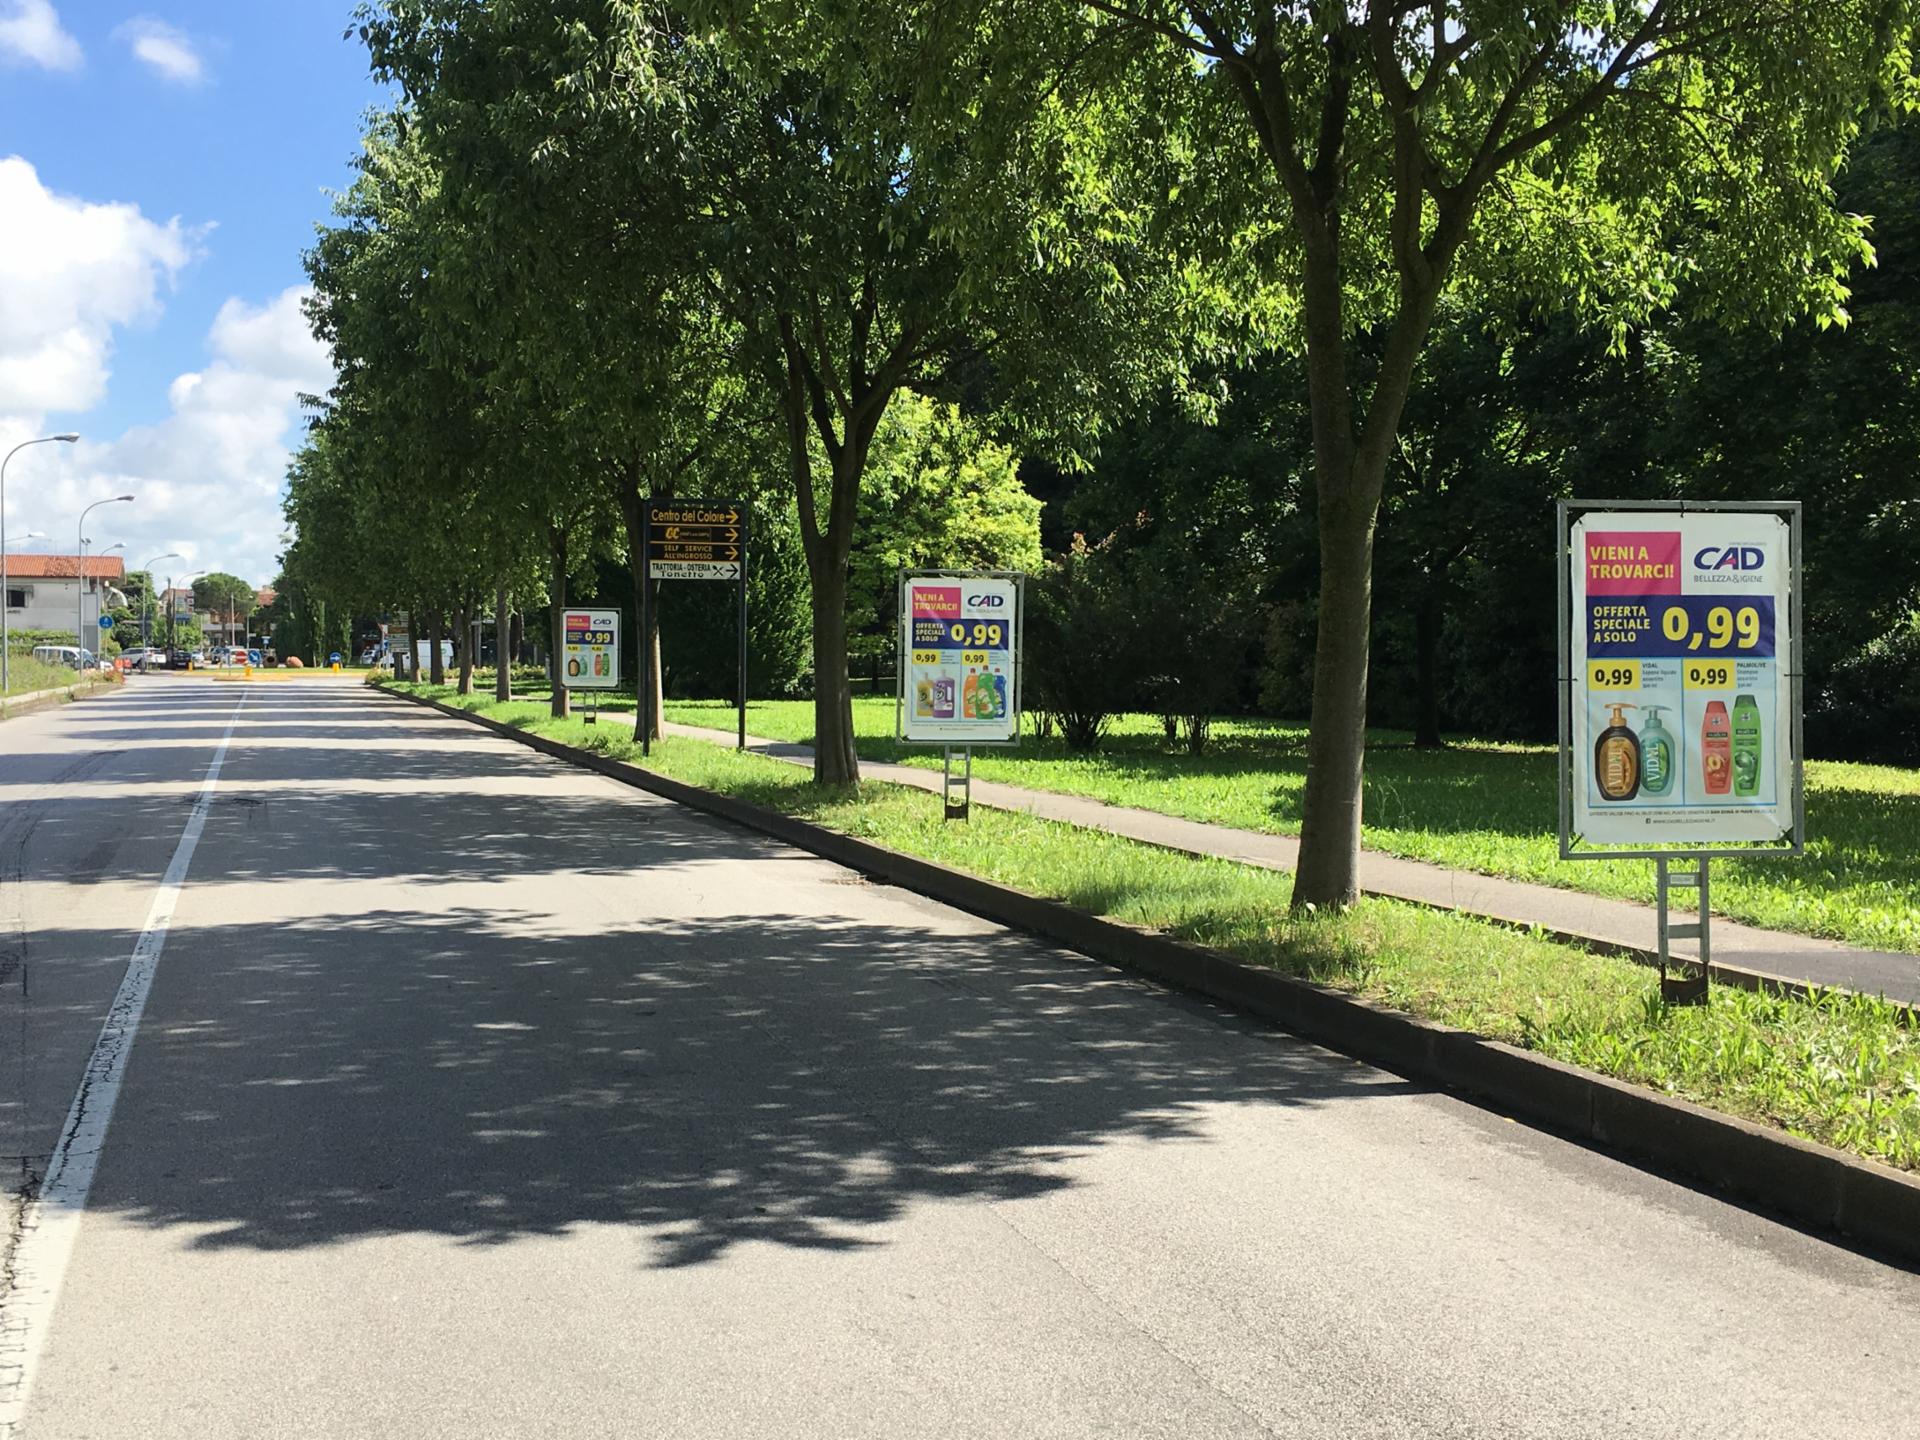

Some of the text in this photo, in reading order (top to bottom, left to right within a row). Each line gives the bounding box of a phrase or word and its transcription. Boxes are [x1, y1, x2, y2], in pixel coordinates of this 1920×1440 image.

[651, 509, 725, 522] Centro del Colore
[1590, 546, 1649, 560] VIENI A
[1694, 547, 1764, 570] CAD
[652, 563, 683, 571] TRATTORIA
[687, 563, 711, 571] OSTERIA
[1590, 564, 1675, 578] TROVARCI!
[967, 595, 1004, 607] CAD
[1593, 606, 1647, 617] OFFERTA
[1593, 619, 1651, 630] SPECIALE
[1662, 606, 1760, 651] 0,99
[585, 632, 610, 643] 0,99
[951, 624, 1001, 646] 0,99
[1593, 632, 1637, 643] A SOLO
[916, 654, 936, 663] 0,99
[965, 654, 984, 663] 0,99
[1594, 669, 1633, 686] 0,99
[1690, 668, 1728, 686] 0,99
